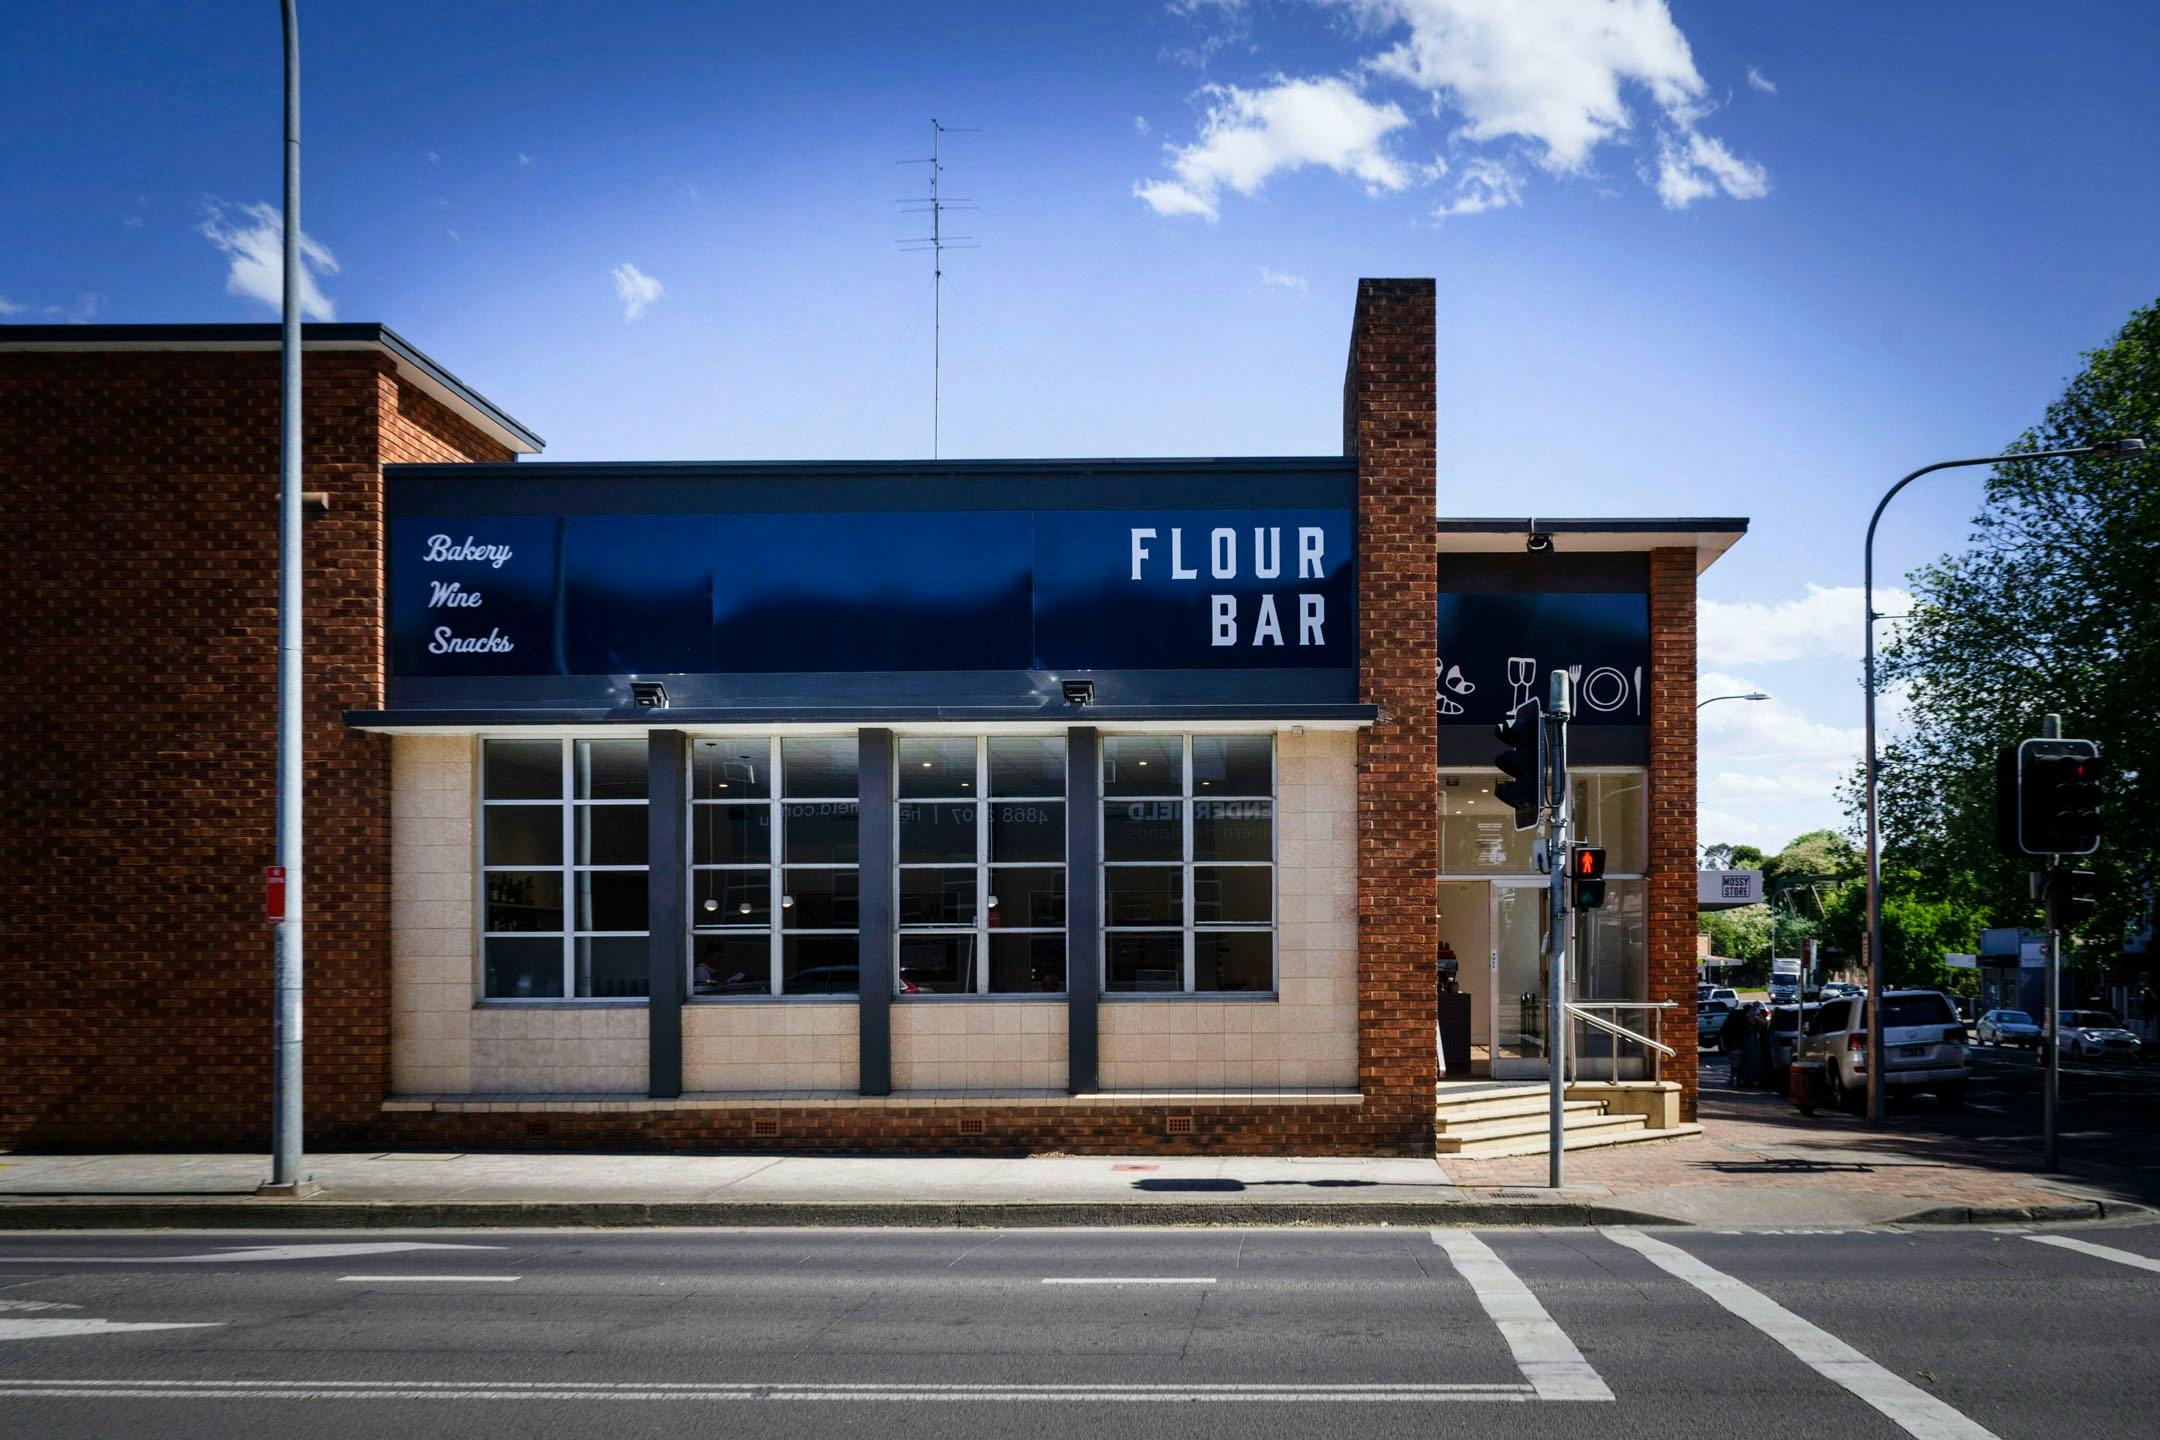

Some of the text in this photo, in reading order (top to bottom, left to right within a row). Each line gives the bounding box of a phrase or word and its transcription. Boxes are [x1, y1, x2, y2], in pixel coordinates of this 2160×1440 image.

[423, 534, 512, 568] Bakery
[1131, 527, 1325, 580] FLOUR
[428, 581, 482, 608] Wine
[1211, 594, 1325, 646] BAR
[428, 626, 514, 654] Snacks
[1723, 877, 1749, 886] MOSSY
[1724, 887, 1748, 896] STORE
